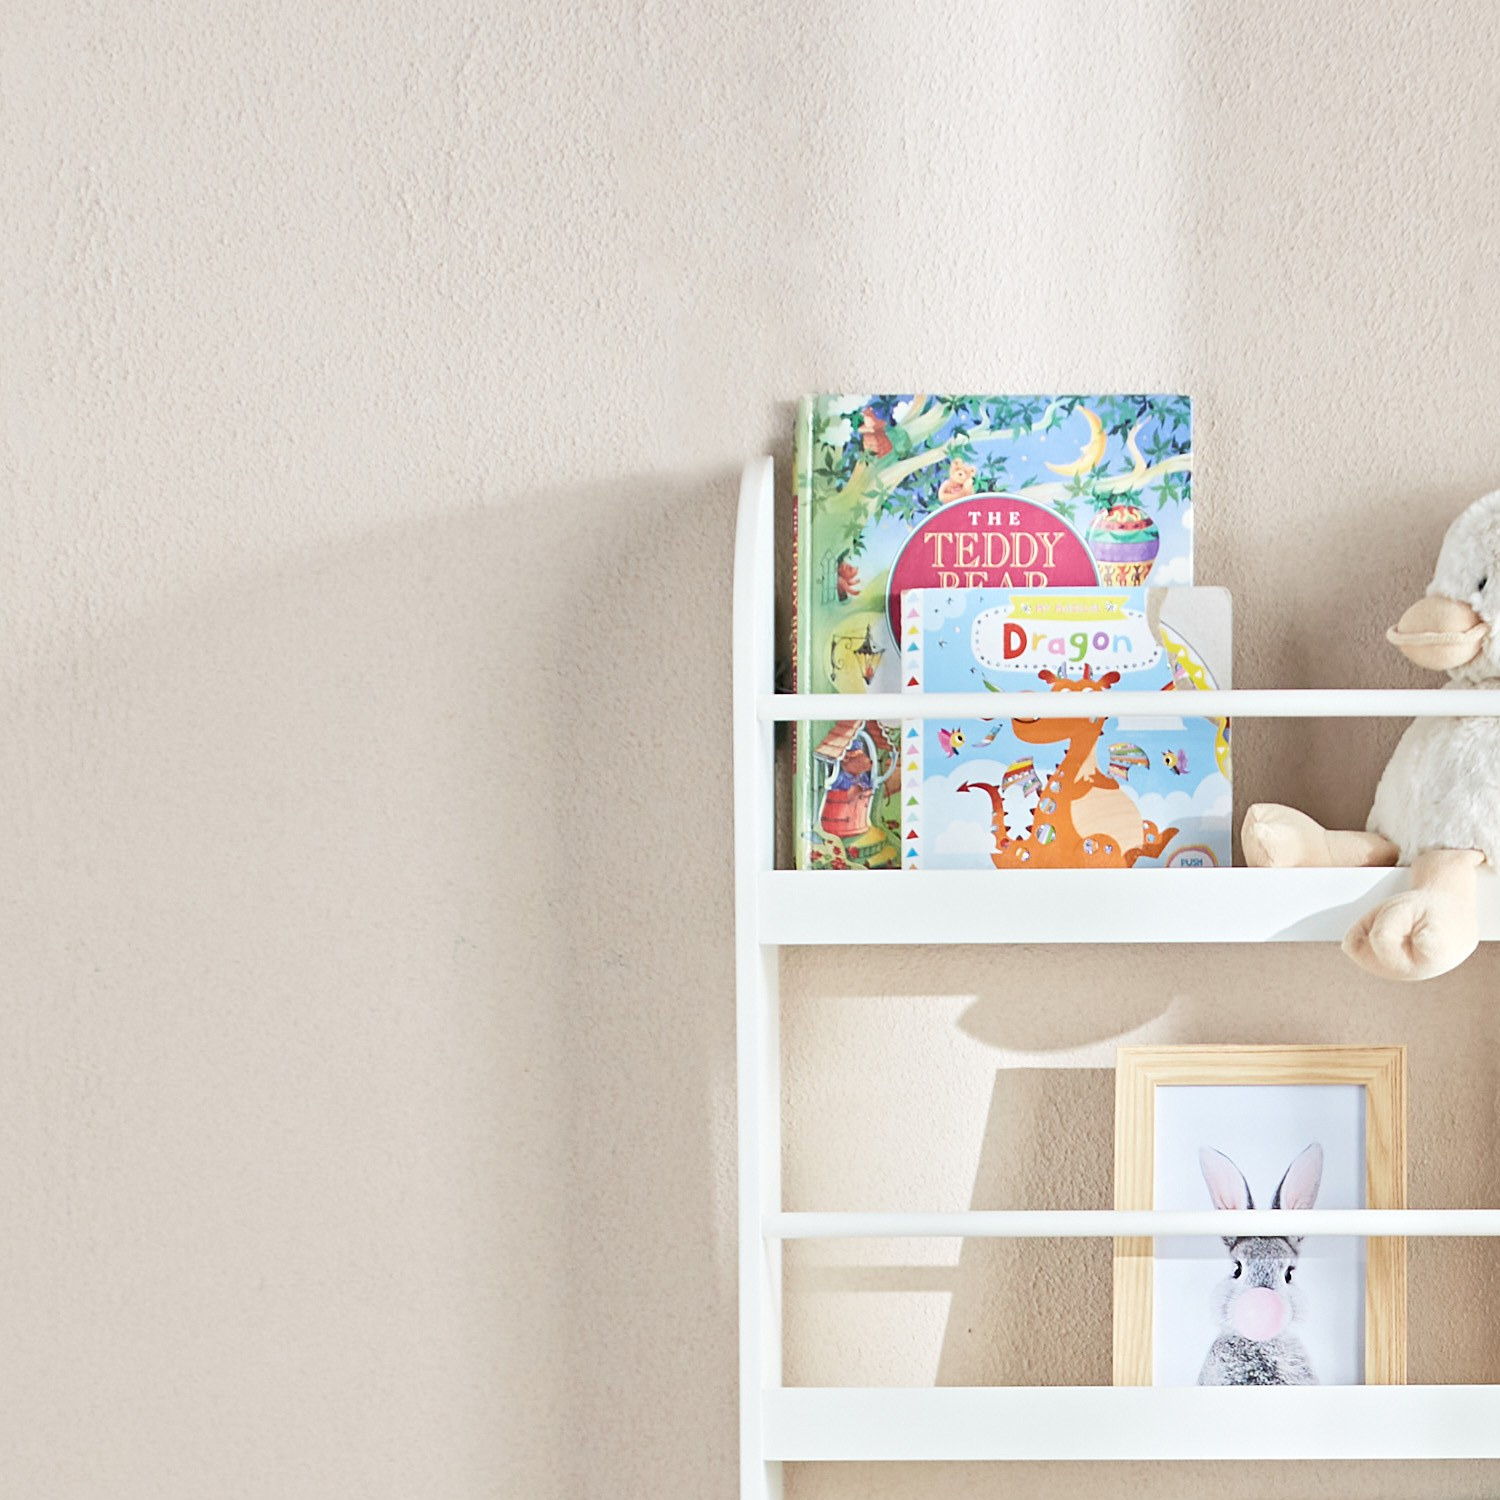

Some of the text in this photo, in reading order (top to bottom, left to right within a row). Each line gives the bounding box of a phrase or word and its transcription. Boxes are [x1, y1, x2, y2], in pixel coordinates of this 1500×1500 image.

[968, 511, 1020, 526] THE
[924, 532, 1065, 568] TEDDY
[1003, 622, 1132, 662] Dragon
[1181, 858, 1203, 867] PUSH
